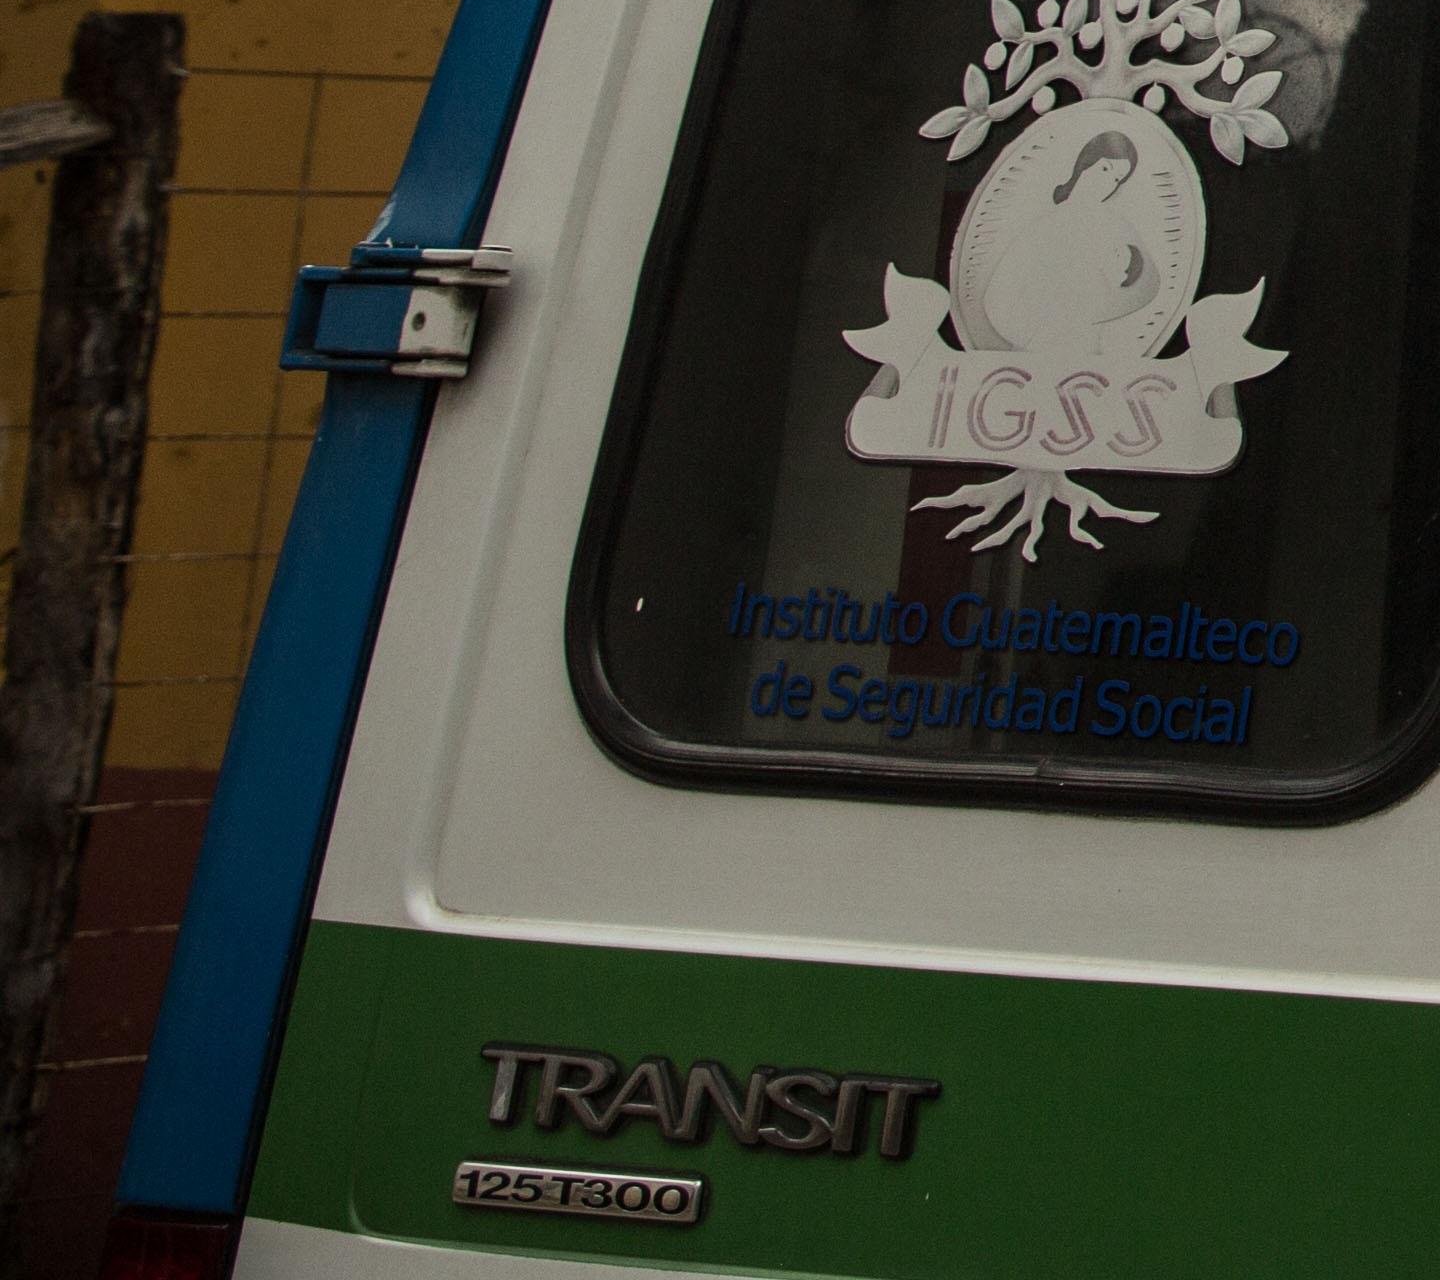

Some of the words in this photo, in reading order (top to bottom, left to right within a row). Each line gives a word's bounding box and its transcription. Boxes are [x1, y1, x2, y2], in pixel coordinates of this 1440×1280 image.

[927, 365, 1178, 457] IGSS
[728, 582, 926, 646] Instituto
[940, 592, 1299, 667] Guatemalteco
[750, 660, 813, 718] de
[820, 663, 1084, 738] Seguridad
[1090, 678, 1254, 746] Social
[480, 1041, 942, 1159] TRANSIT
